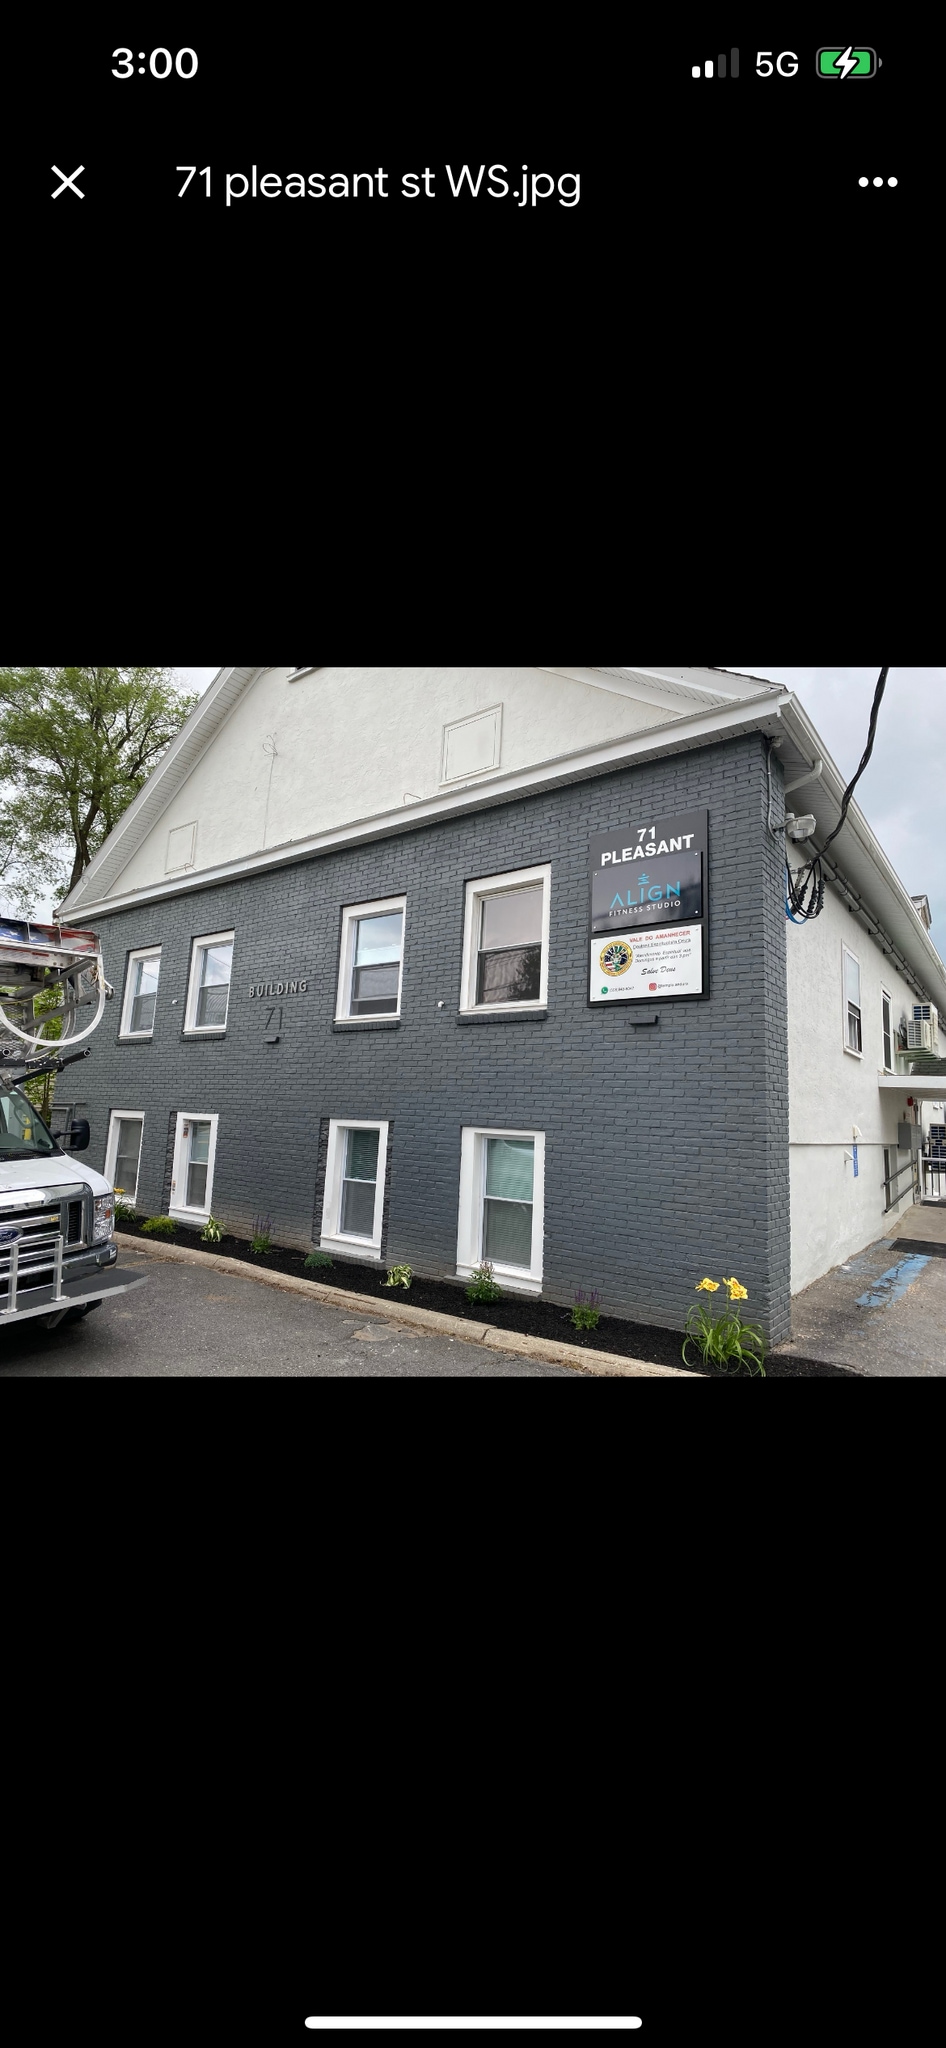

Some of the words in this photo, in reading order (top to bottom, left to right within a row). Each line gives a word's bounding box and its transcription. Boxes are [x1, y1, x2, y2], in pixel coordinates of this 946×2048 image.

[637, 826, 656, 842] 71
[601, 834, 694, 866] PLEASANT
[610, 881, 681, 909] ALIGN
[609, 906, 643, 917] FITNESS
[646, 900, 681, 911] STUDIO
[655, 931, 691, 940] AMANHECER
[249, 980, 307, 998] BUILDING
[265, 1007, 283, 1030] 71
